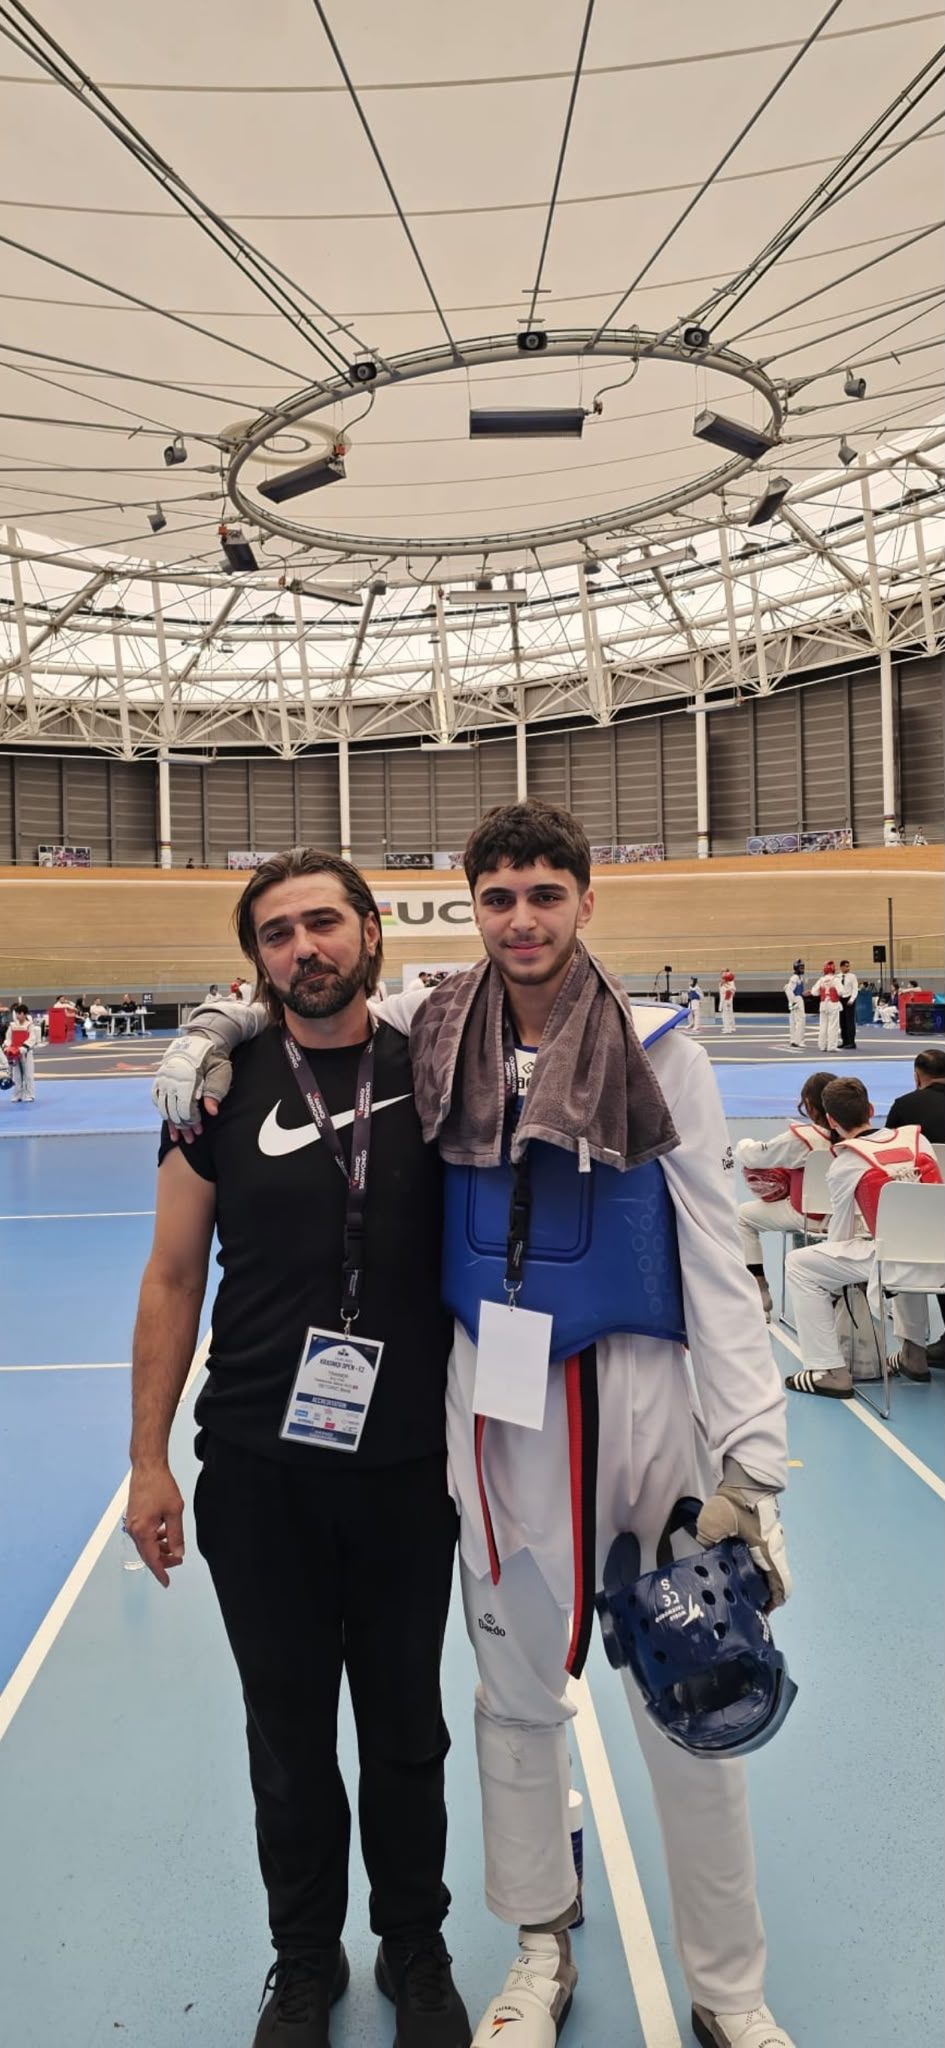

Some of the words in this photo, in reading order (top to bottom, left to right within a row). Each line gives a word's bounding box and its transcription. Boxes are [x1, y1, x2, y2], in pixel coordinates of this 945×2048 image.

[397, 901, 473, 925] UC
[722, 1158, 734, 1170] Dae
[661, 1578, 671, 1591] S
